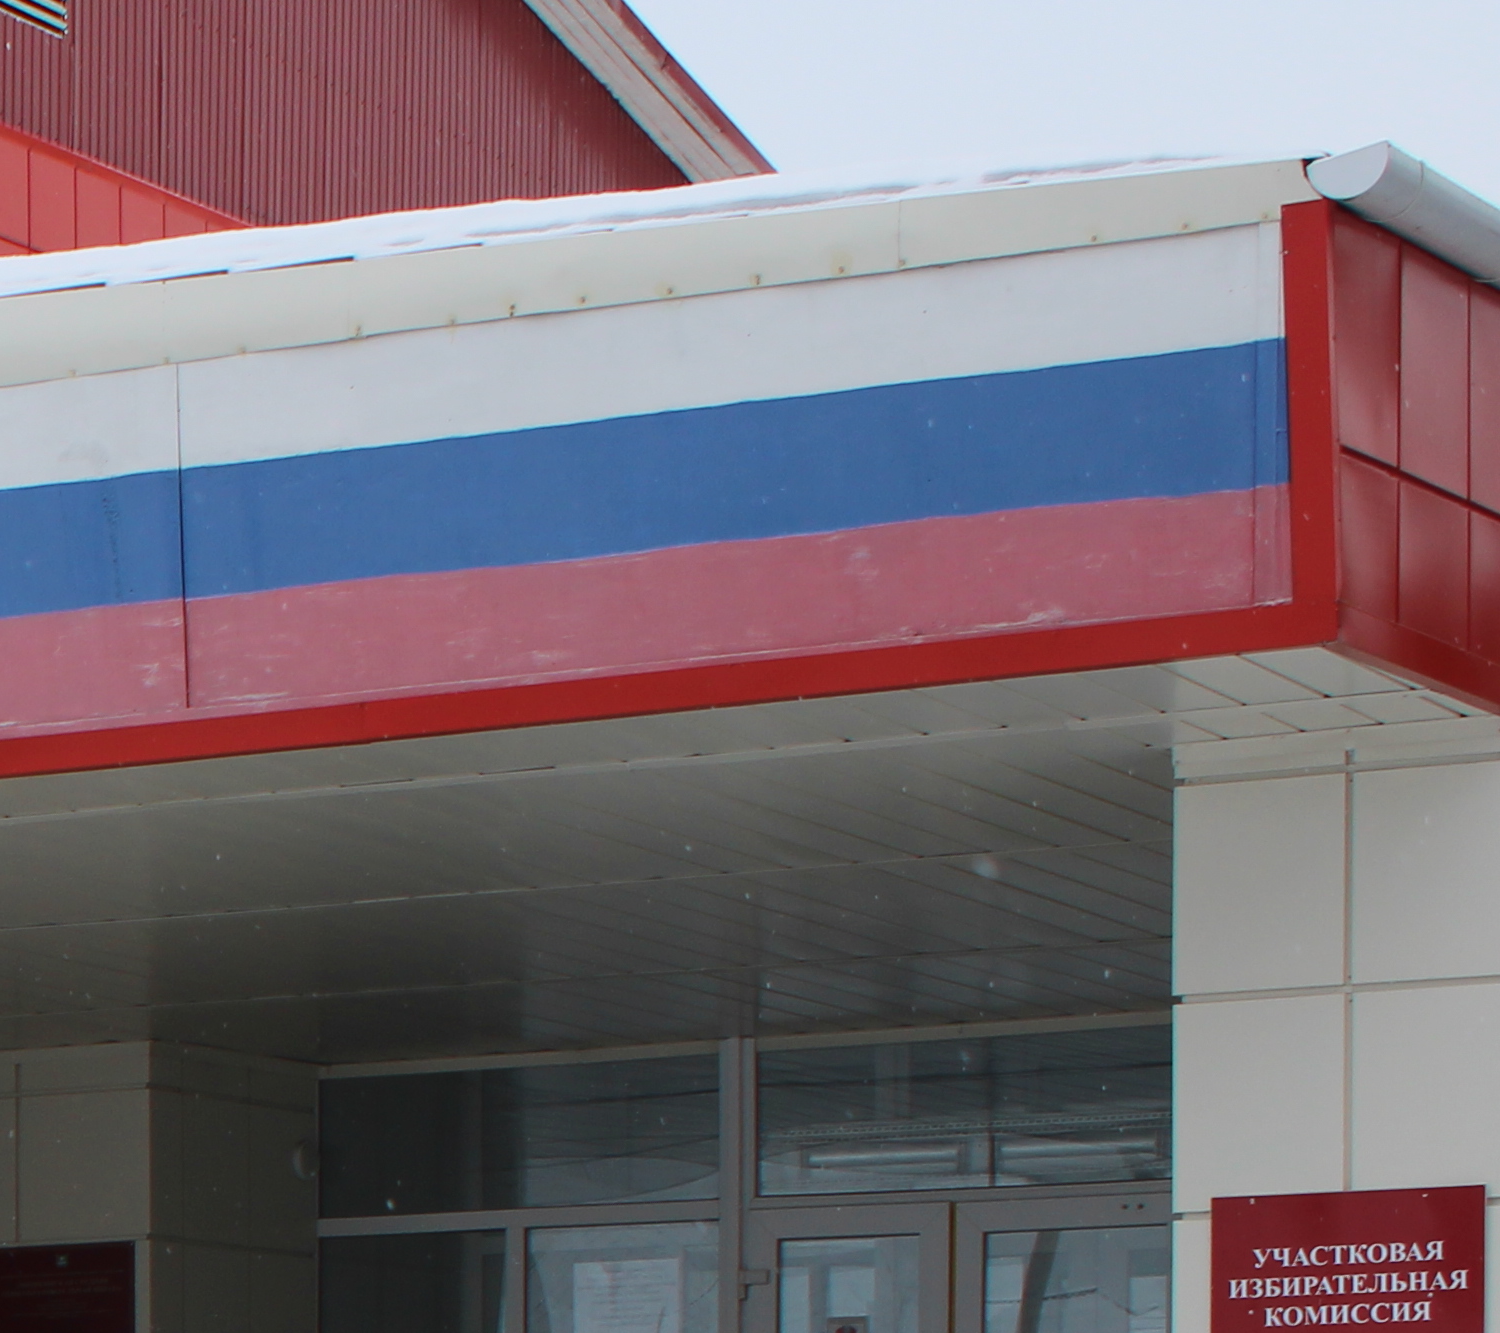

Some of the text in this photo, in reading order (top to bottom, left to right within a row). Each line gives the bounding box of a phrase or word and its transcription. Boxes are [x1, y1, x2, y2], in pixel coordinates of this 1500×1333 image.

[1252, 1240, 1445, 1269] УЧАСТКОВАЯ
[1228, 1269, 1470, 1300] ИЗБИРАТЕЛЬНАЯ
[1264, 1300, 1433, 1328] КОМИССИЯ
